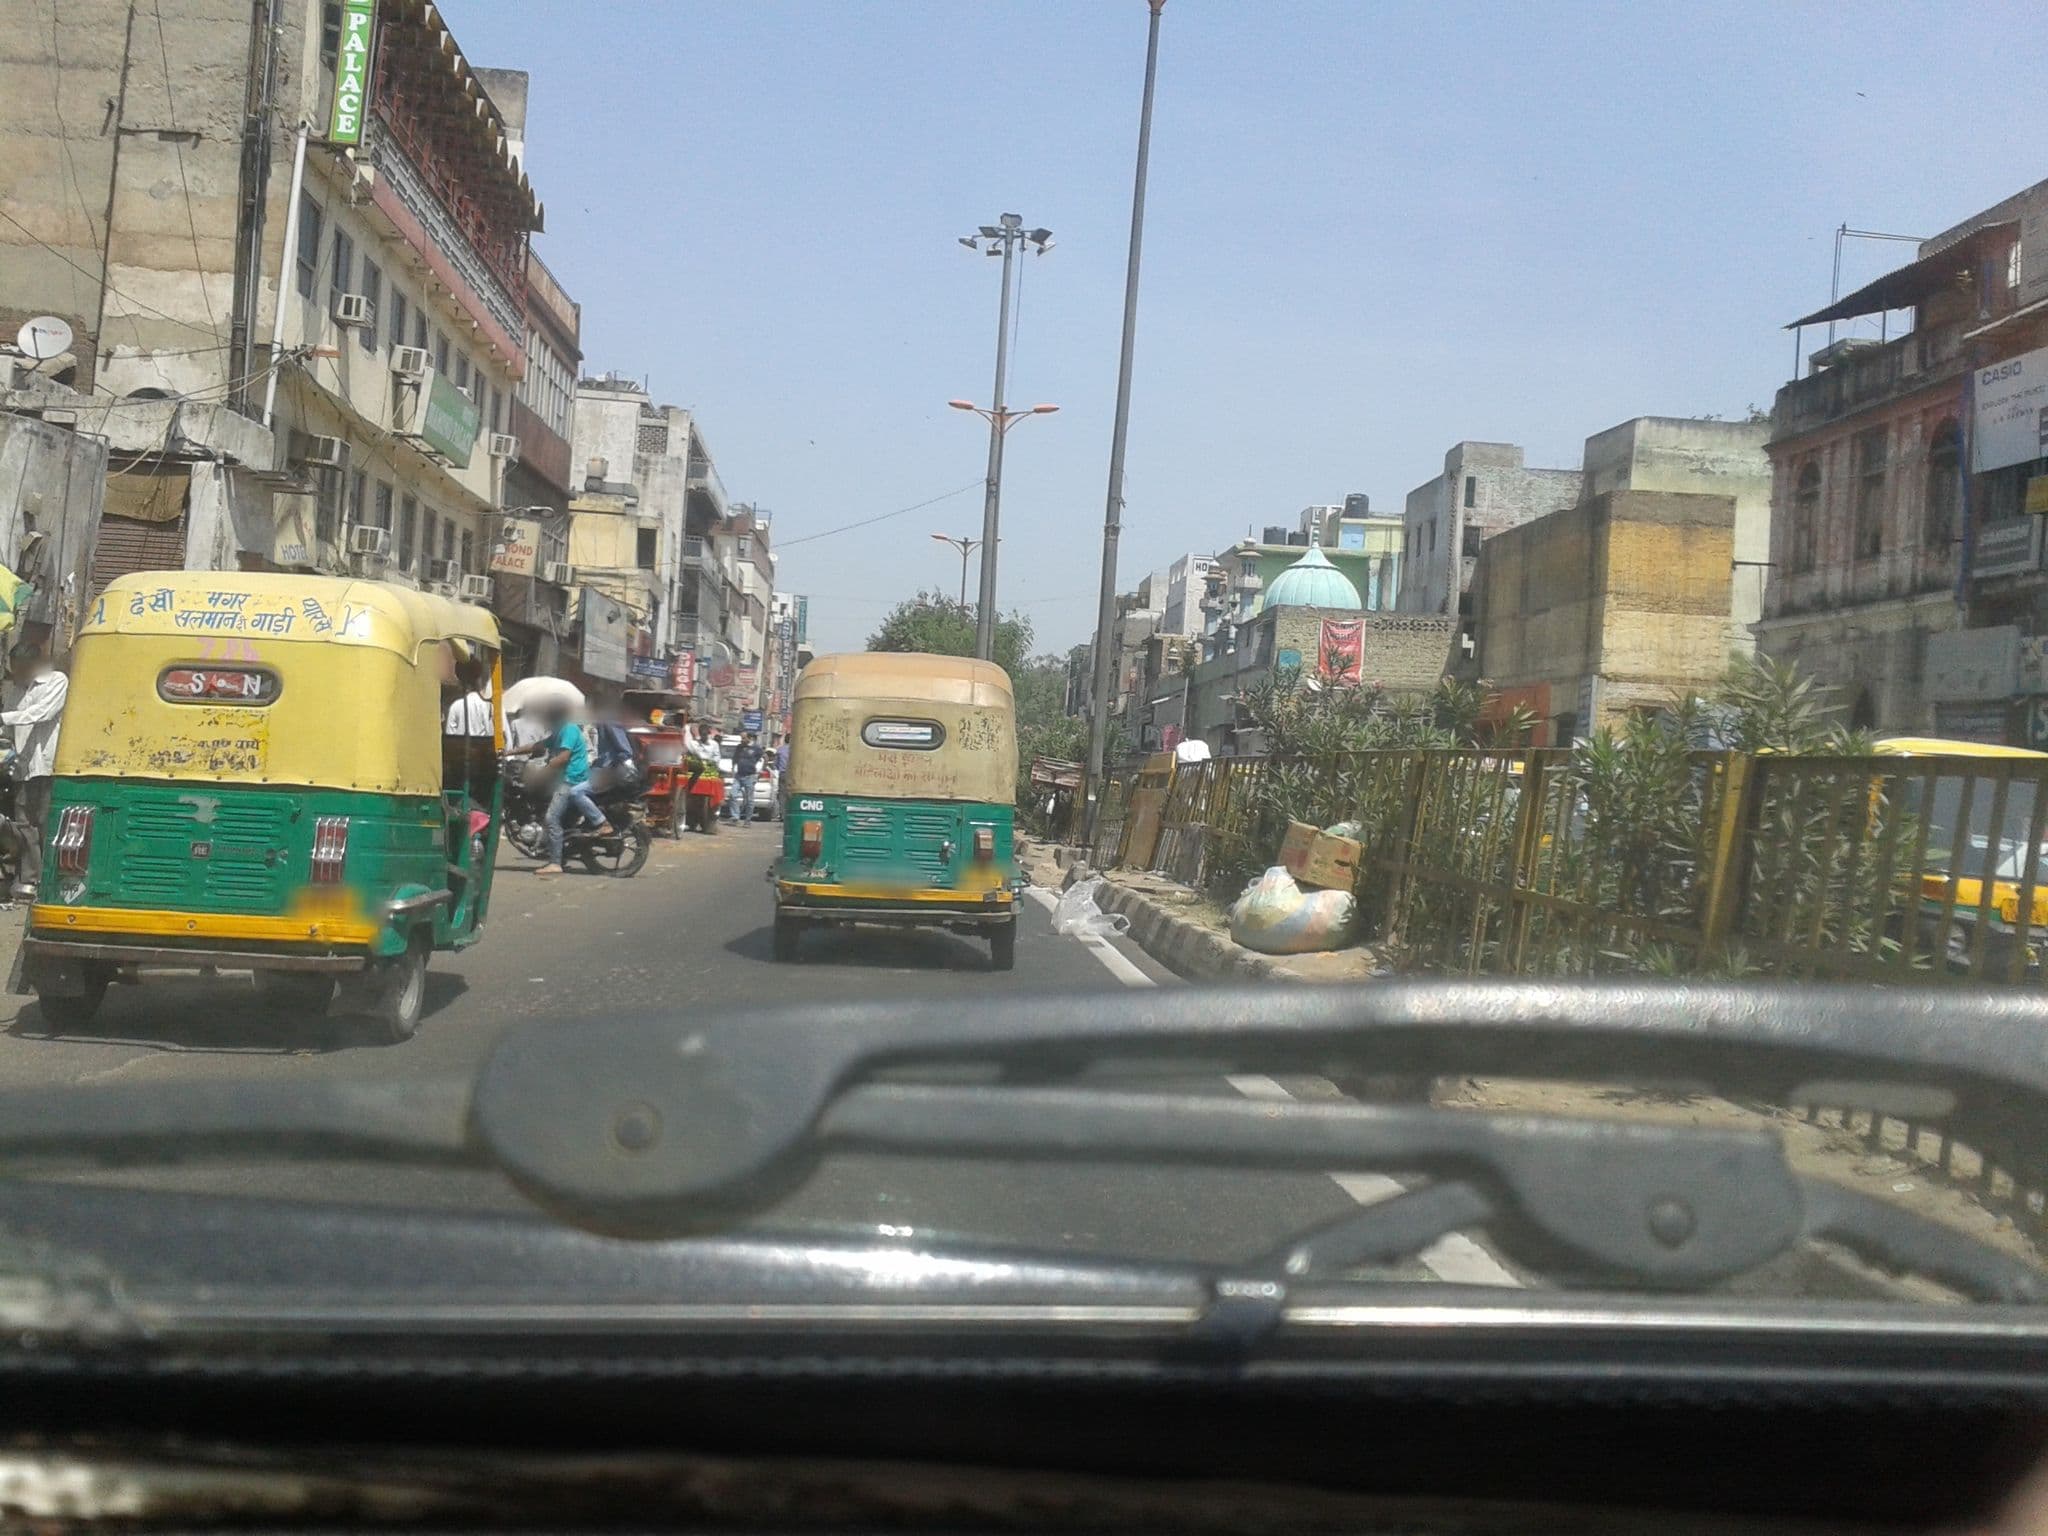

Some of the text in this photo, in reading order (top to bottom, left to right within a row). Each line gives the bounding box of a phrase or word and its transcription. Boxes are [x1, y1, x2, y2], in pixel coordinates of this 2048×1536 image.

[337, 12, 367, 133] PALACE
[1982, 361, 2022, 385] CASIO
[175, 610, 239, 630] सलमान
[801, 800, 824, 811] CNG
